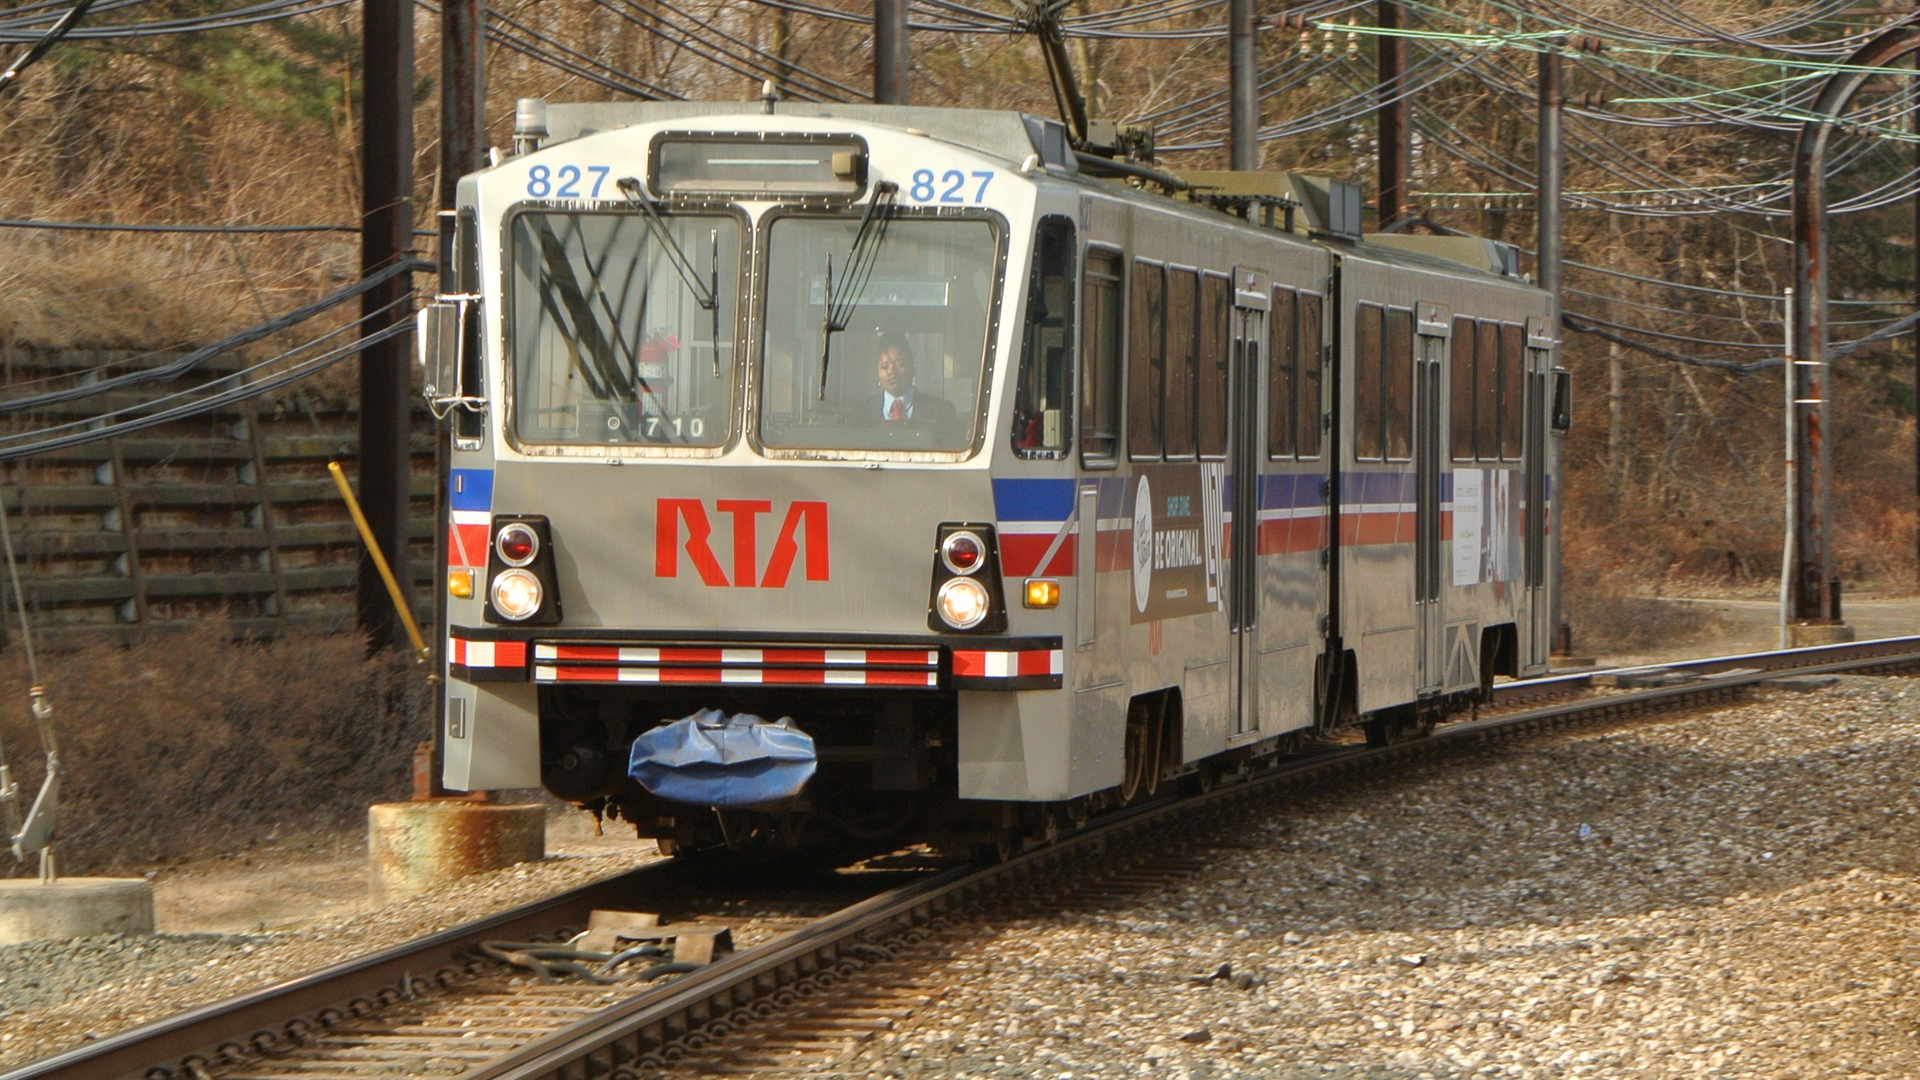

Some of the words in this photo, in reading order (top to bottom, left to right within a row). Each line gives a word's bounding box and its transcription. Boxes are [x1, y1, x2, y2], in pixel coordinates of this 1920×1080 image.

[527, 164, 611, 199] 827
[909, 168, 995, 204] 827
[654, 498, 830, 588] RTA
[1154, 531, 1165, 570] BE
